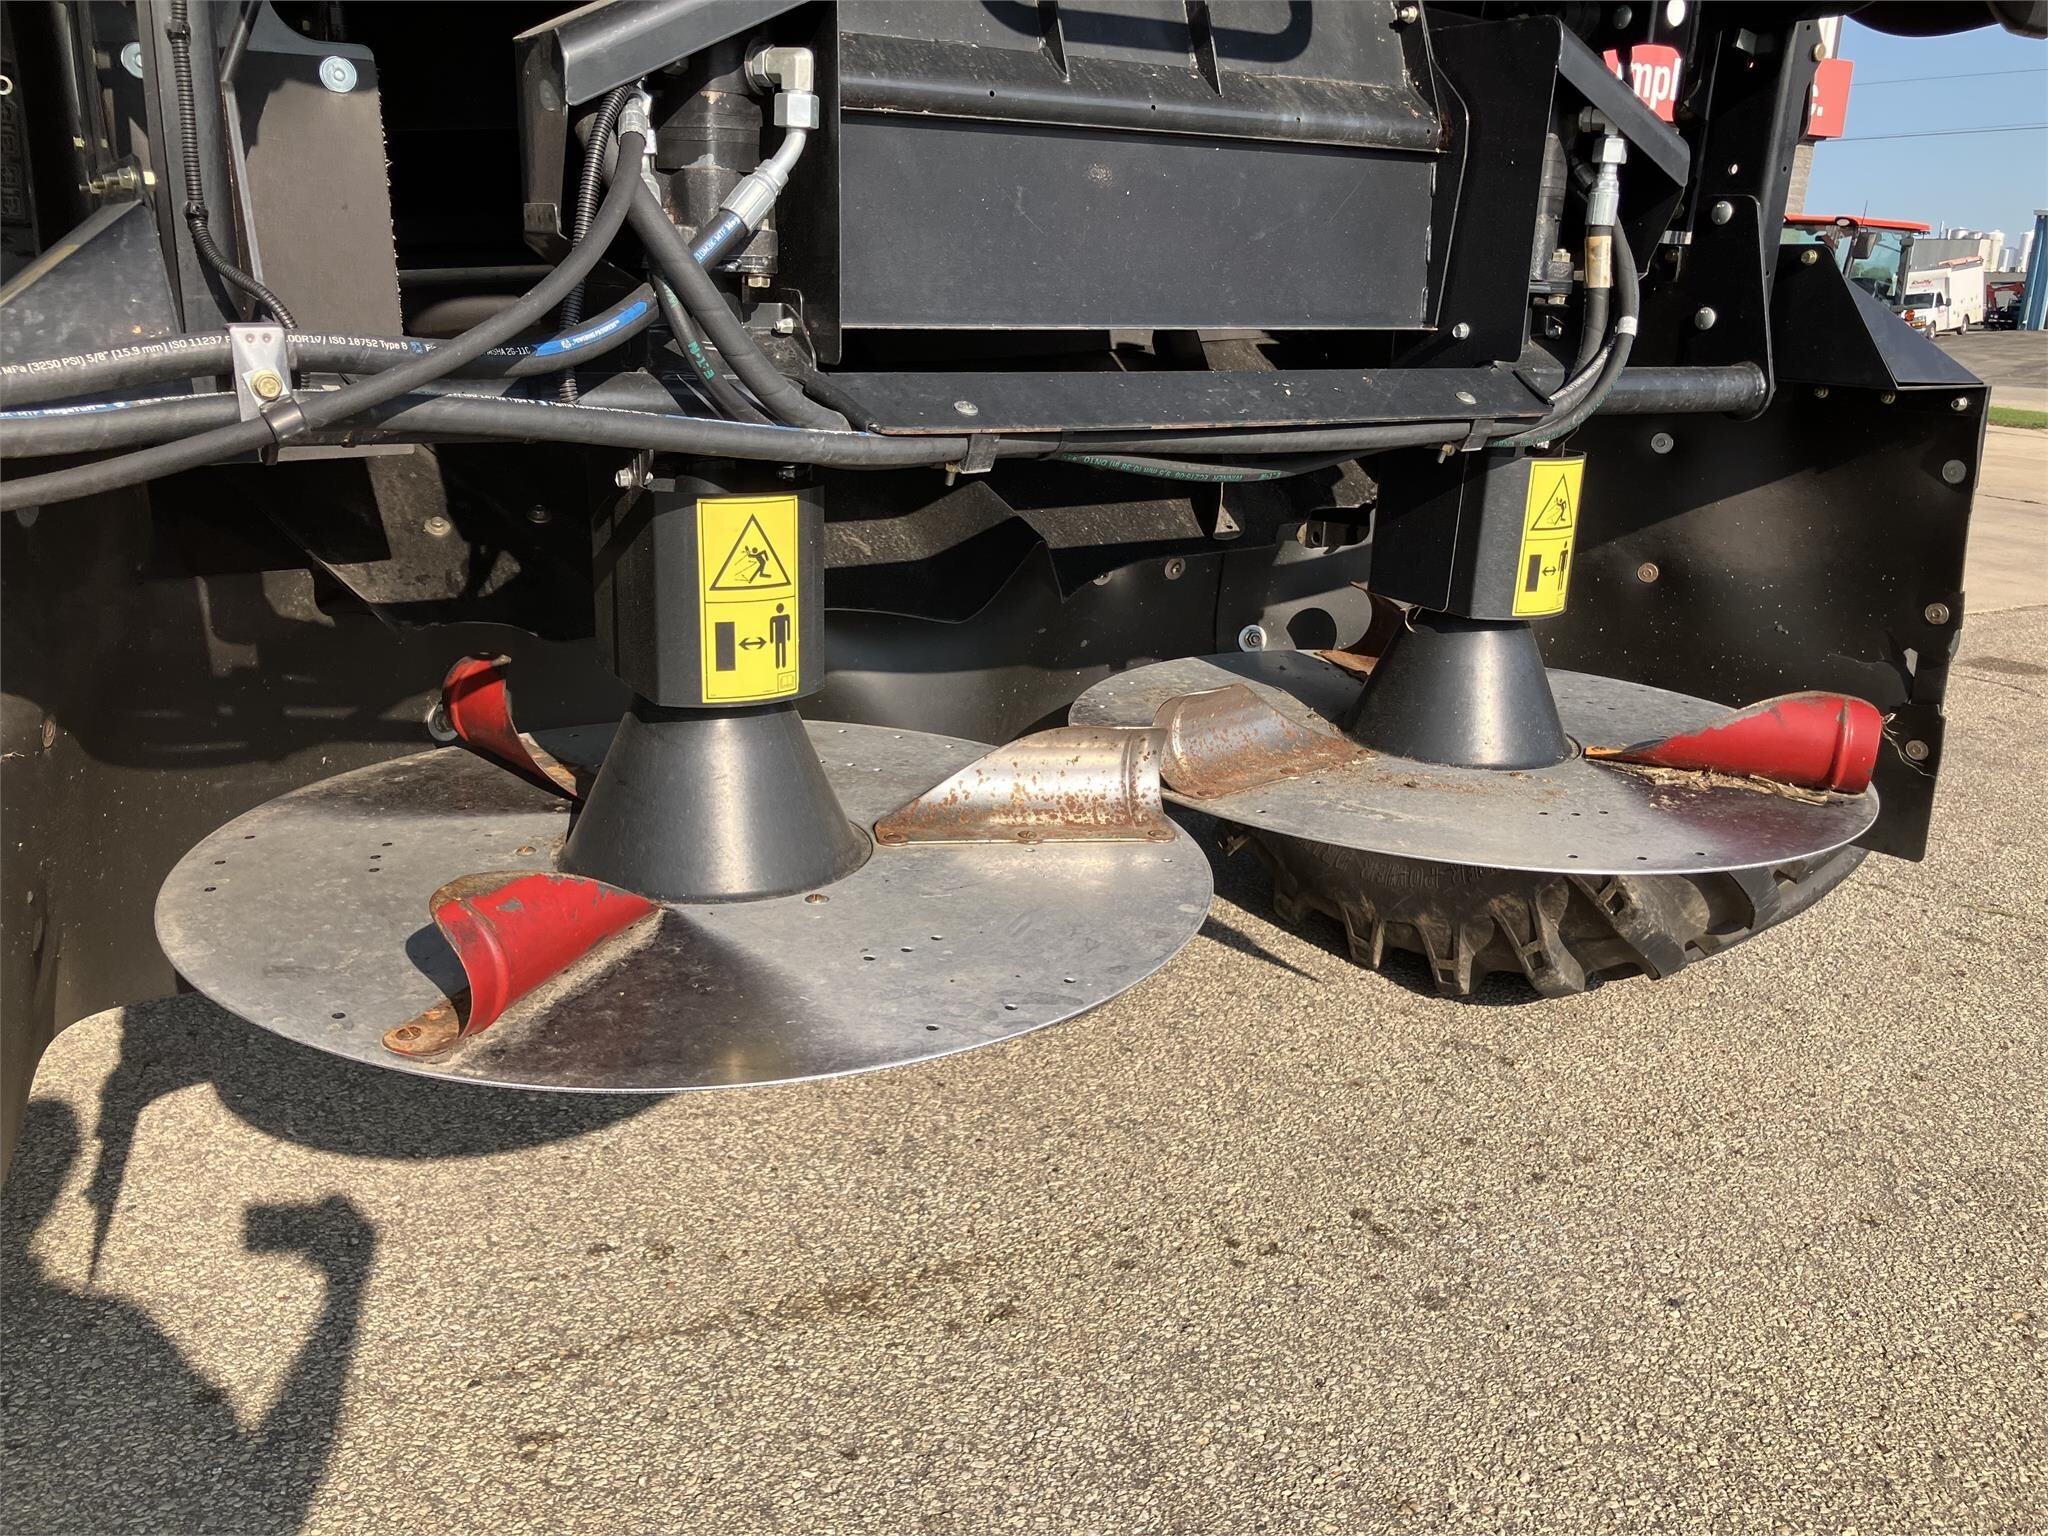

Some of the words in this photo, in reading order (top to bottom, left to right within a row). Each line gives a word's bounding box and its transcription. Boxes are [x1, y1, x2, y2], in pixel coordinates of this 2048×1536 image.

[168, 339, 187, 350] ISO
[189, 335, 222, 347] 11237
[329, 336, 346, 345] ISO
[349, 337, 378, 348] 18752
[381, 340, 400, 351] Type
